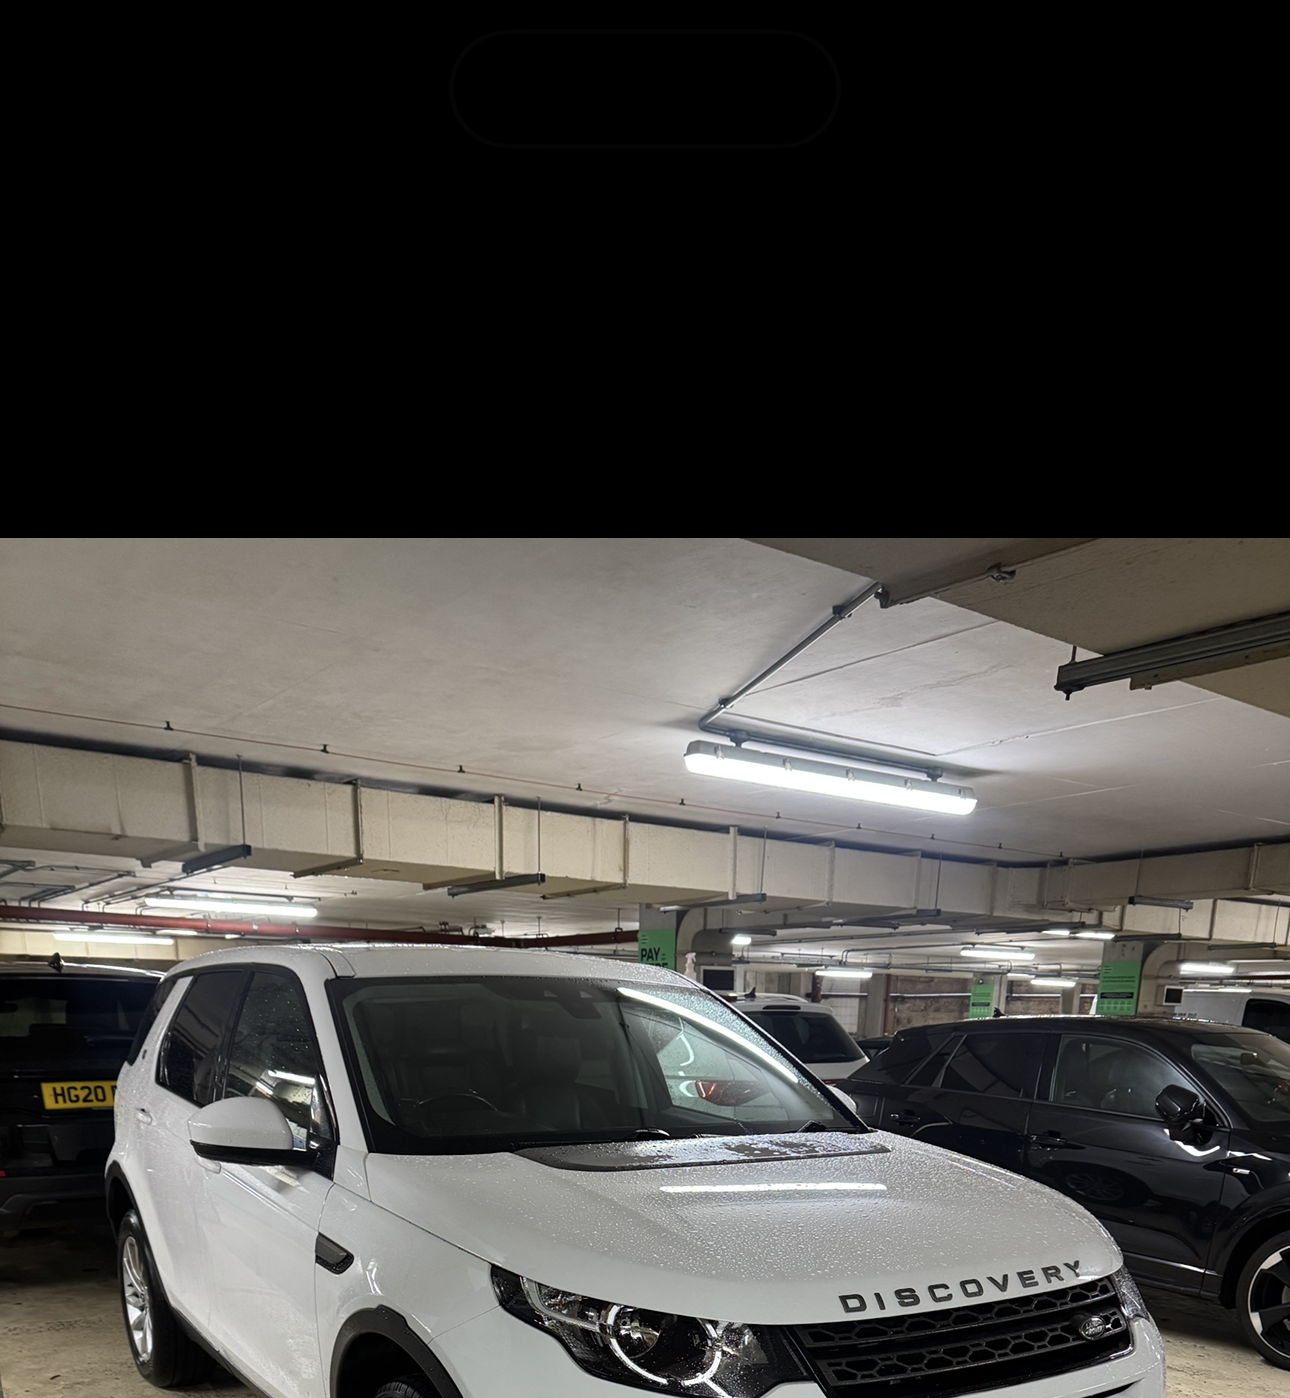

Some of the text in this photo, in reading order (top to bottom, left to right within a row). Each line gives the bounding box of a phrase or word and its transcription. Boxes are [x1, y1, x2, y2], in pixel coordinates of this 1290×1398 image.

[641, 947, 660, 961] PAY
[52, 1086, 106, 1104] HG20
[839, 1260, 1080, 1313] DISCOVERY
